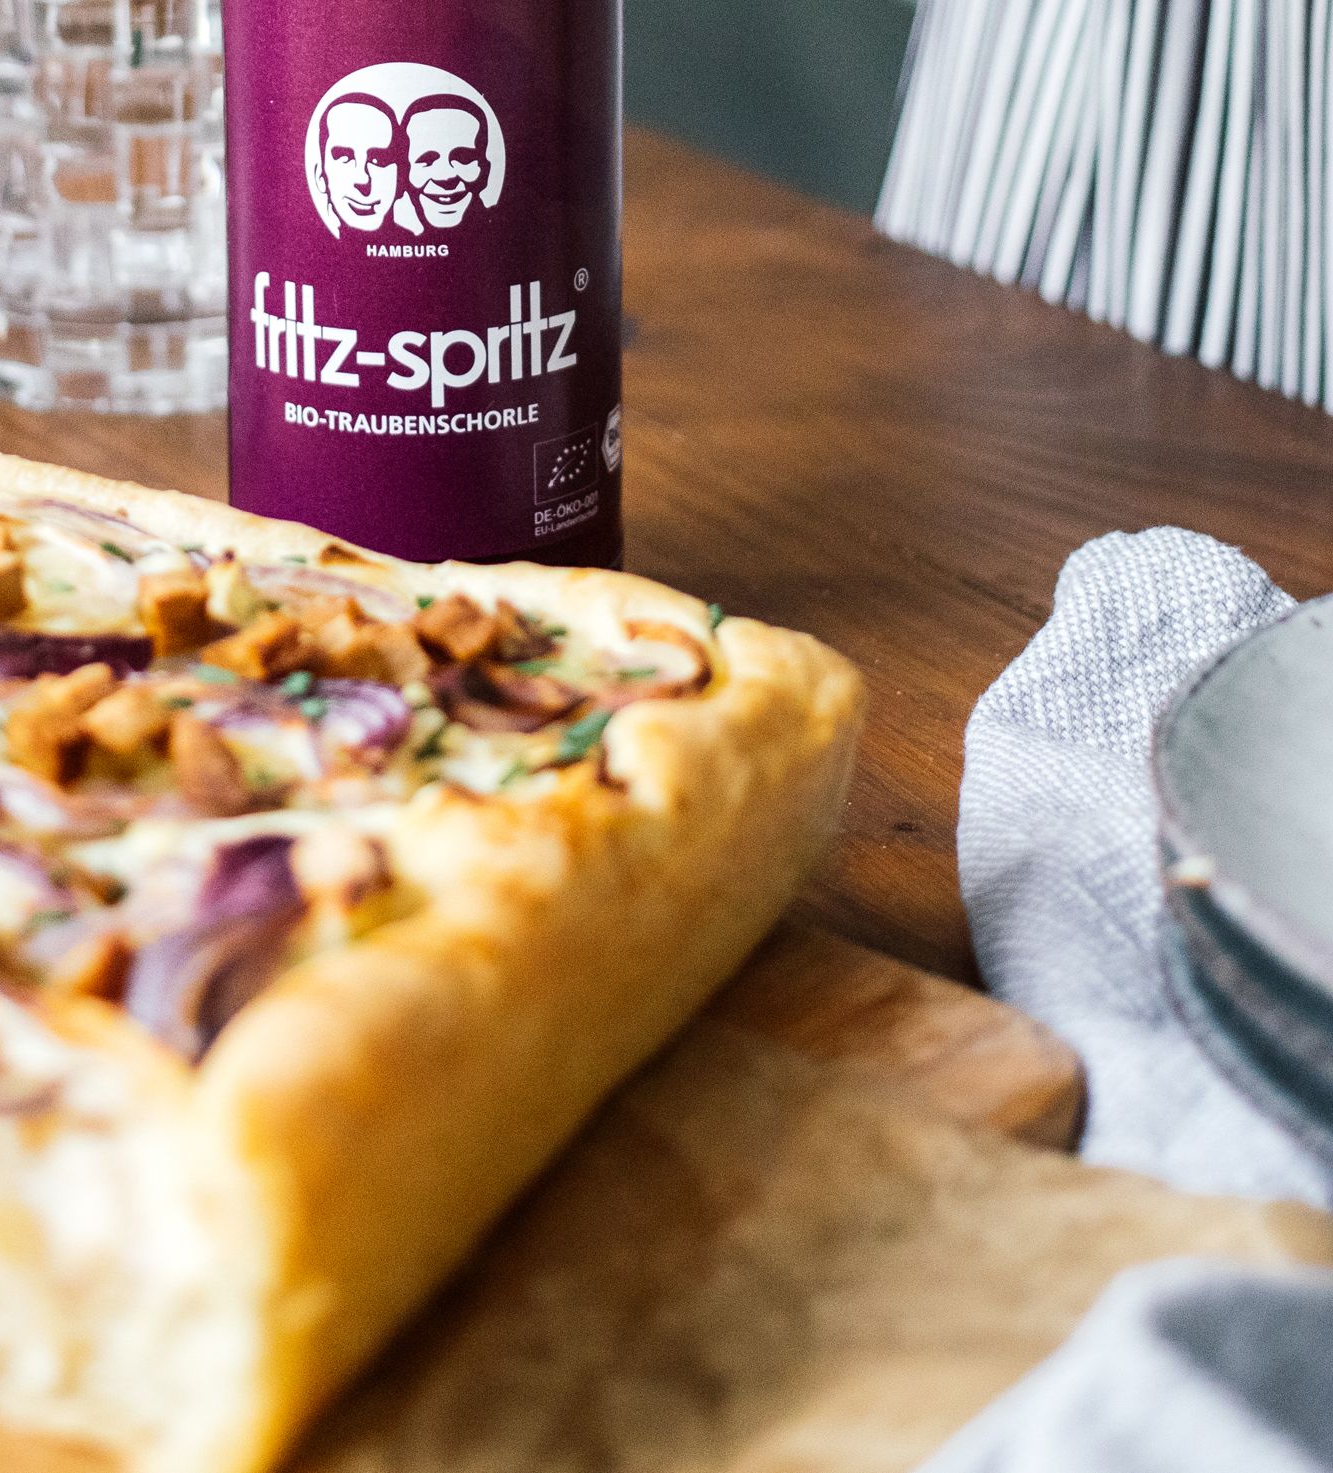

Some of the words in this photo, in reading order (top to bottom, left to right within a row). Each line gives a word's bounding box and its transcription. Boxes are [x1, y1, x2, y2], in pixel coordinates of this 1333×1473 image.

[366, 244, 449, 258] HAMBURG
[250, 271, 578, 409] fritz-spritz
[284, 401, 540, 436] BIO-TRAUBENSCHORLE
